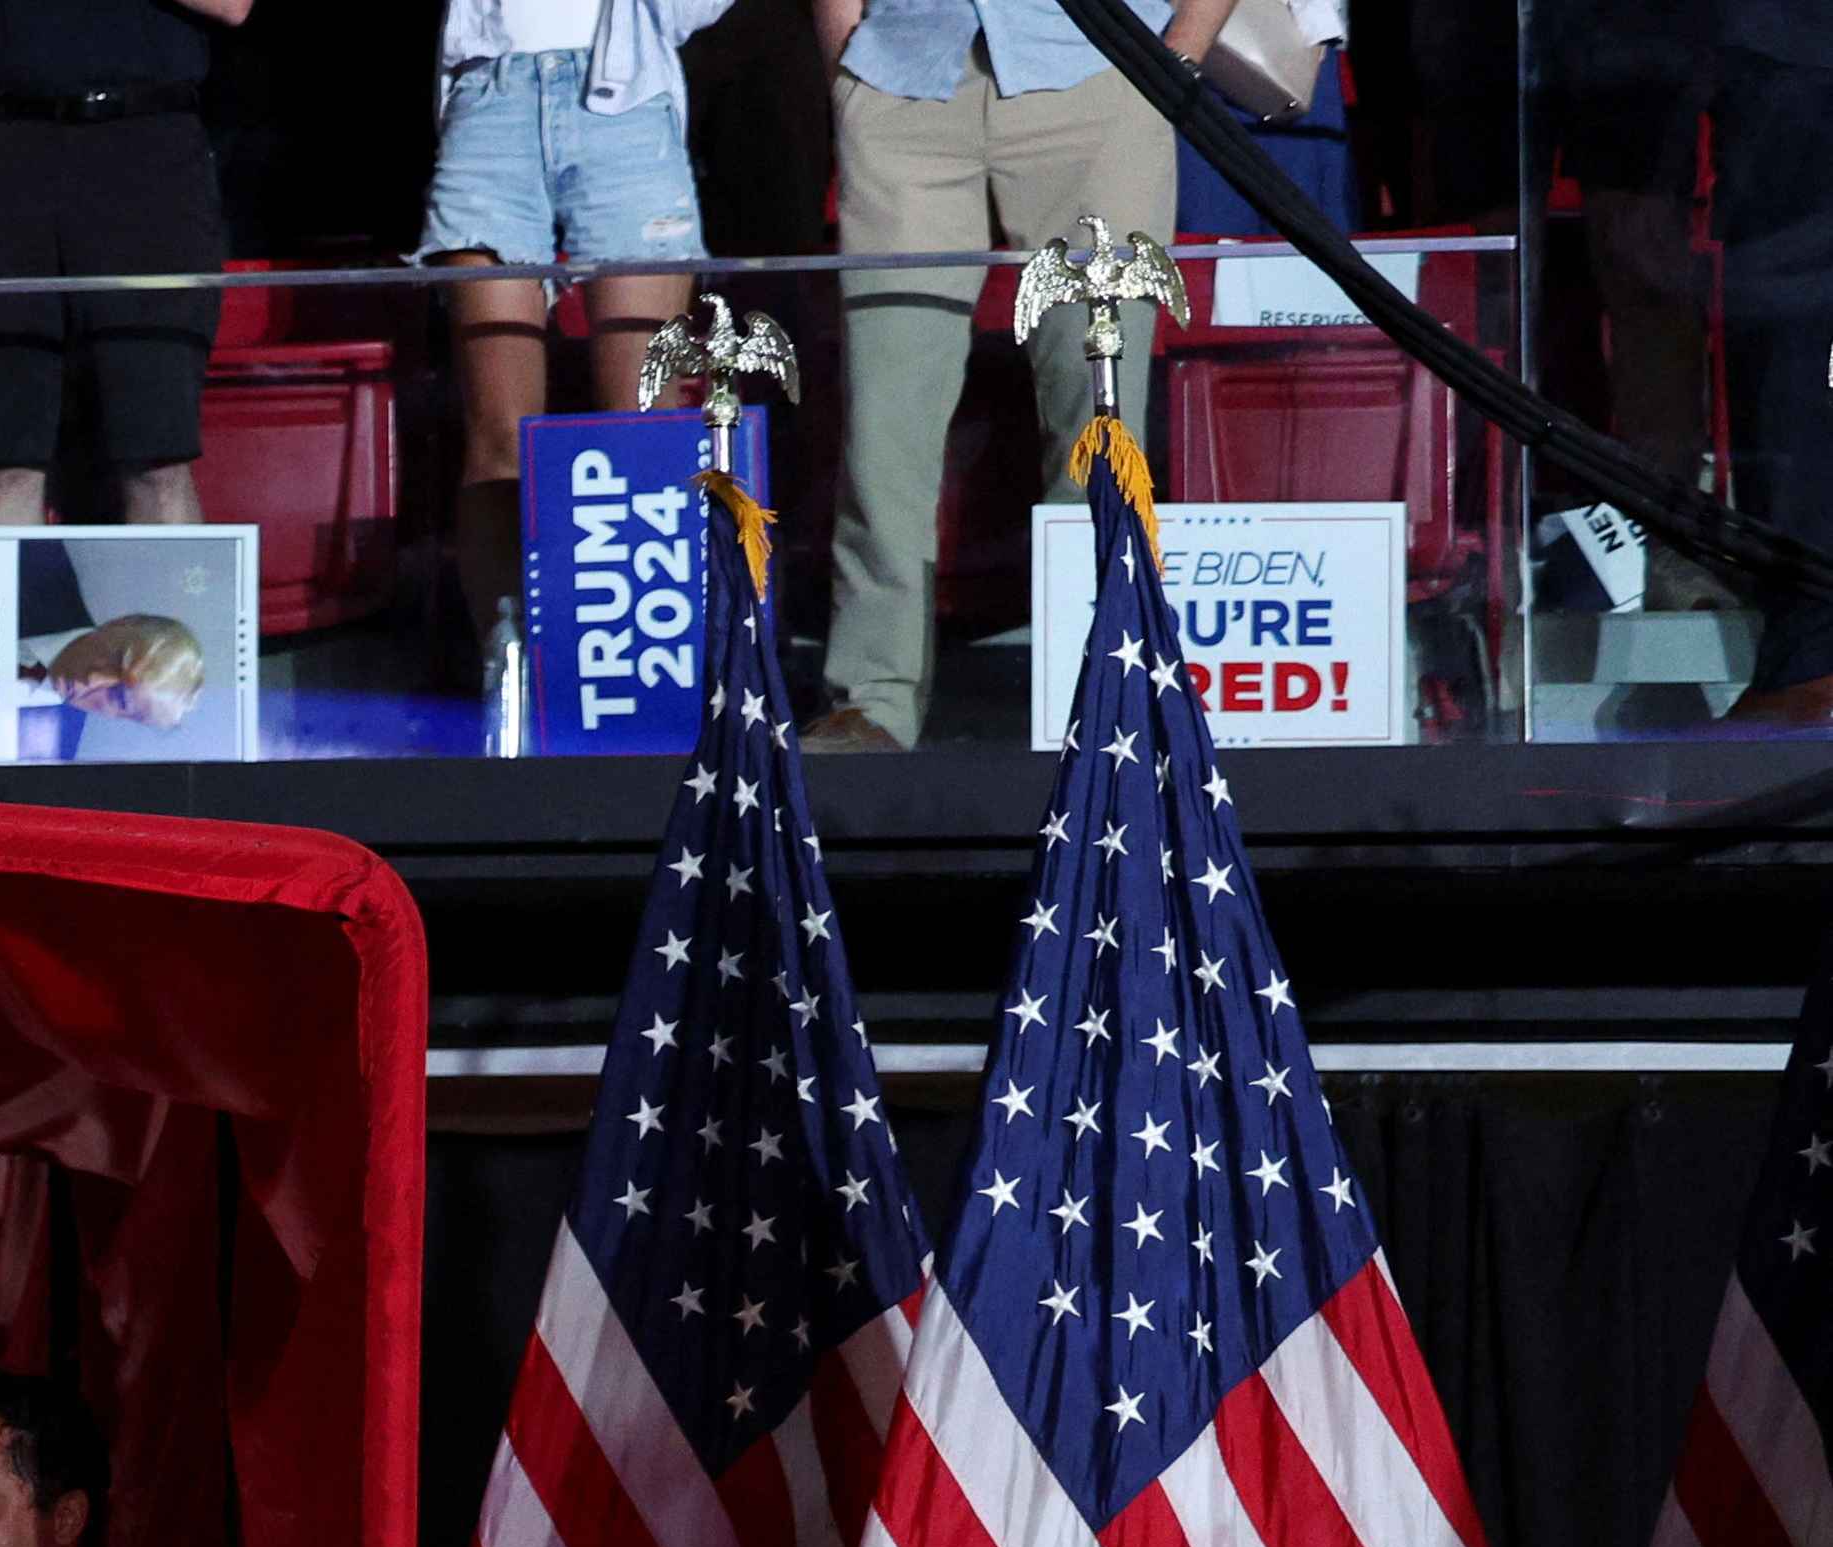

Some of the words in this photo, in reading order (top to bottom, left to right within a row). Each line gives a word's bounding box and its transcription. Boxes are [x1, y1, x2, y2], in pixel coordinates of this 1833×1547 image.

[572, 448, 637, 731] TRUMP
[634, 485, 696, 690] 2024
[1169, 599, 1334, 647] U'RE
[1193, 551, 1326, 588] BIDEN,
